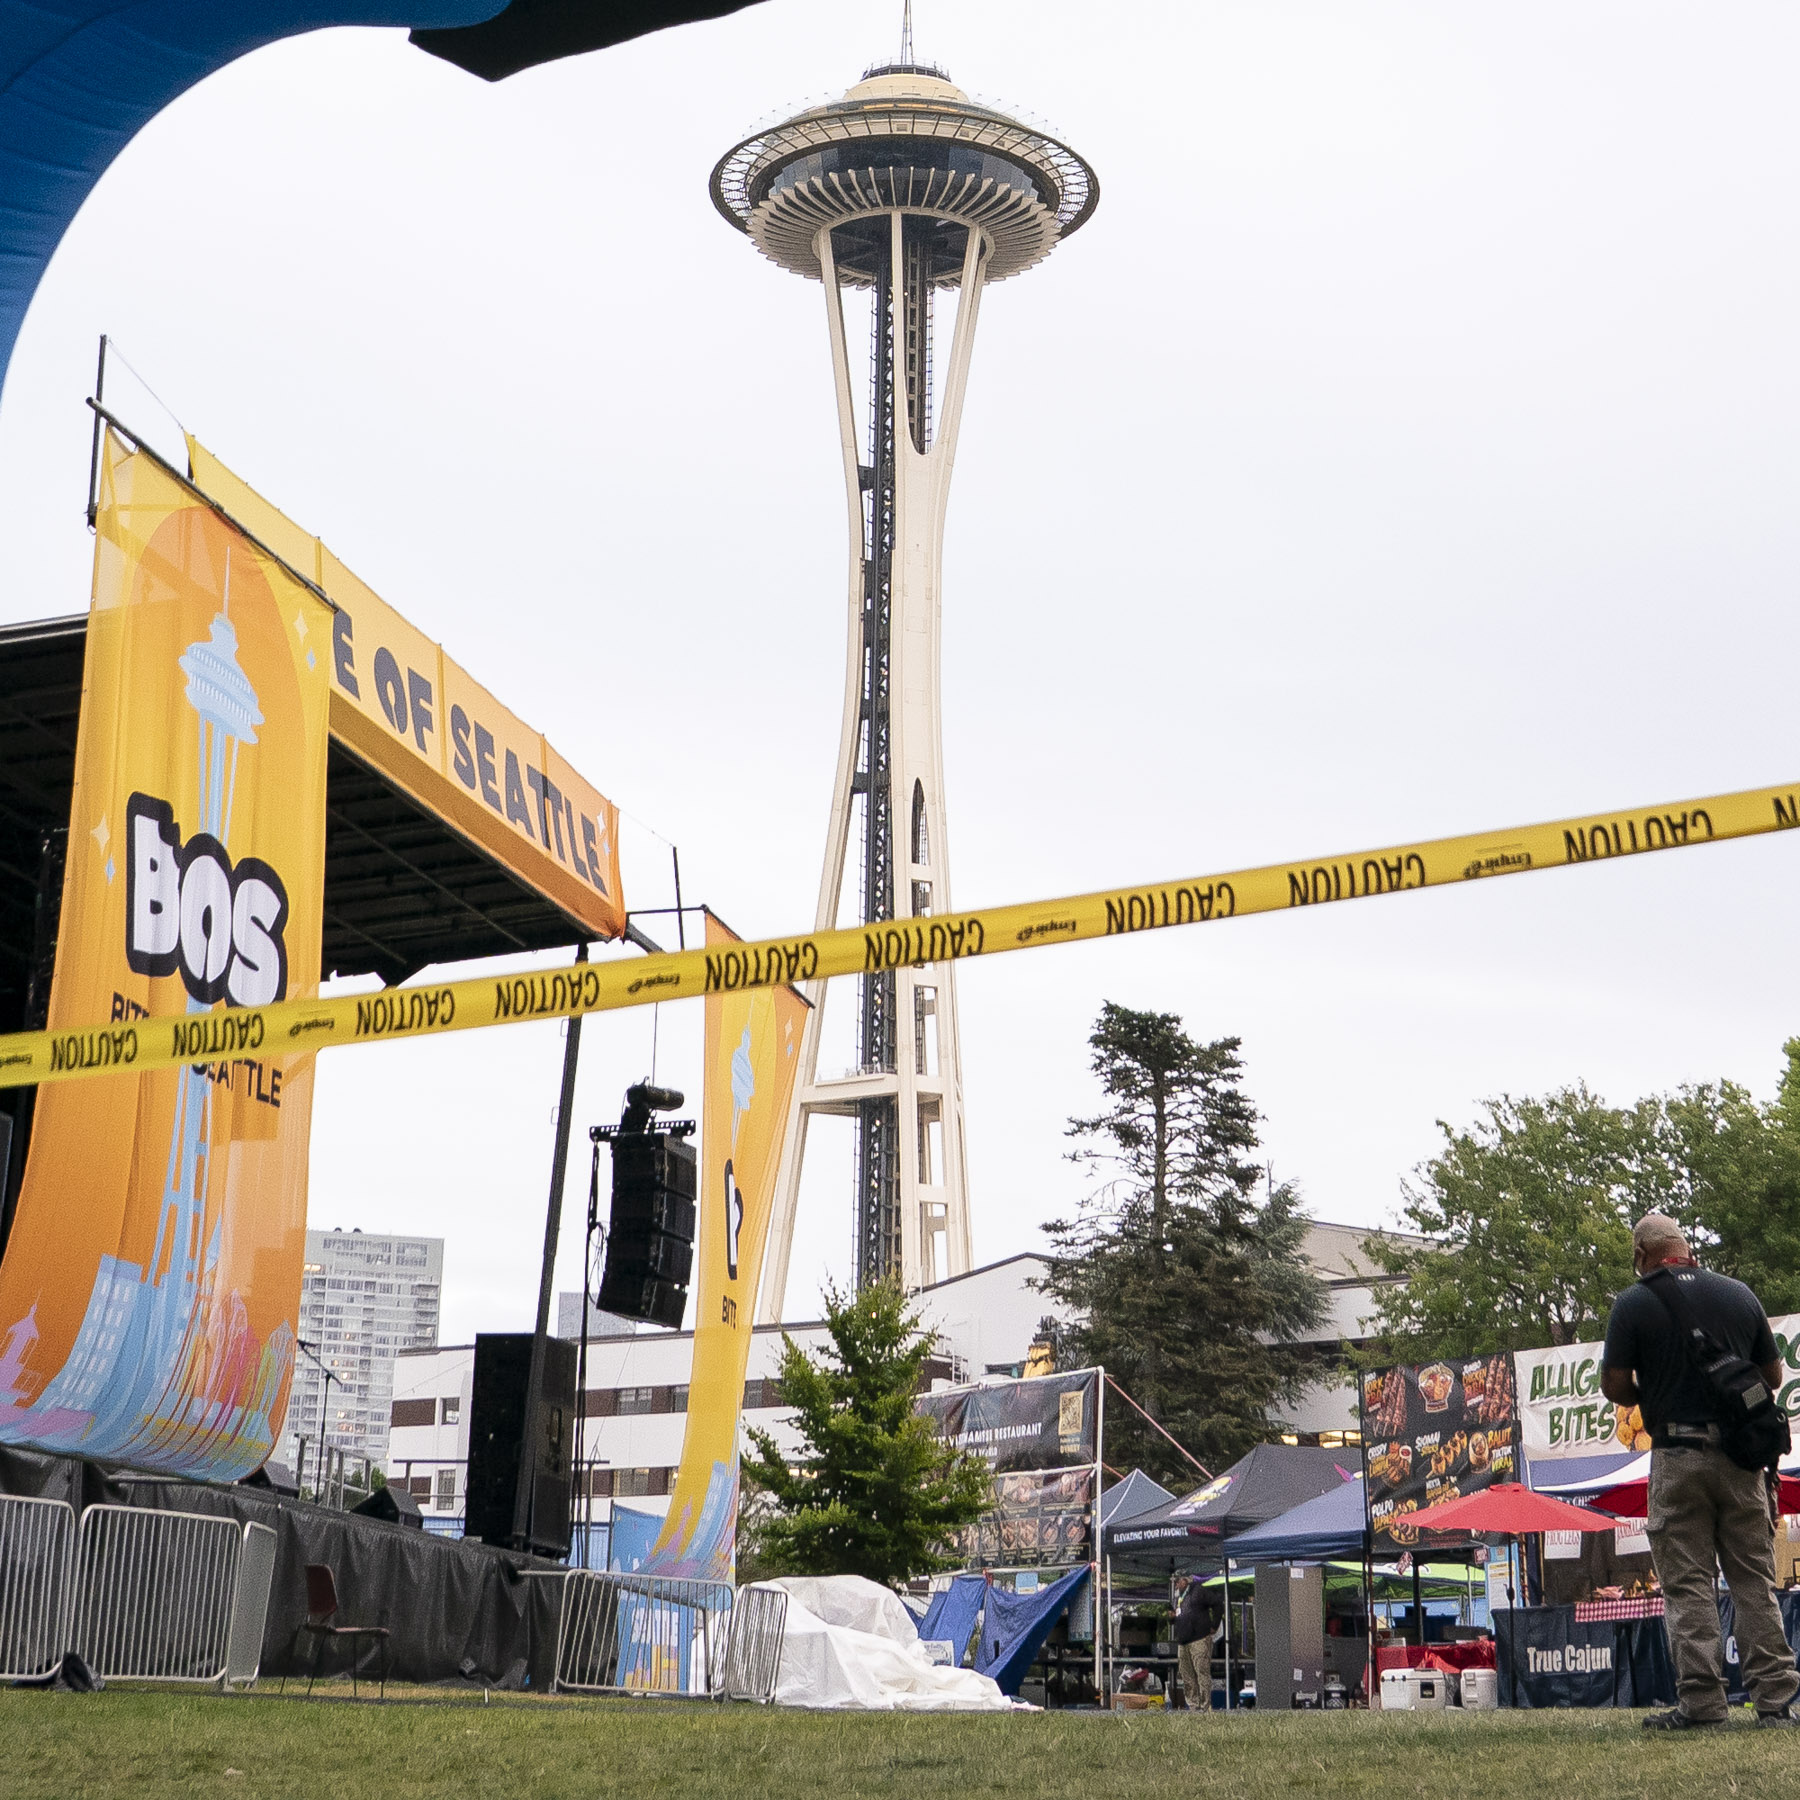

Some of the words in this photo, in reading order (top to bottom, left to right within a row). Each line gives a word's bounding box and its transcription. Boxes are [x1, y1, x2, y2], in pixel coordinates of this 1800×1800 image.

[374, 647, 433, 754] OF
[451, 704, 609, 898] SEATTLE
[128, 800, 286, 1008] BOS
[50, 1029, 138, 1071] CAUTION
[172, 1014, 264, 1058] CAUTION
[355, 989, 454, 1036] CAUTION
[495, 969, 601, 1018] CAUTION
[705, 942, 818, 991] CAUTION
[864, 918, 984, 971] CAUTION
[1105, 882, 1235, 935] CAUTION
[1287, 853, 1425, 907] CAUTION
[1563, 809, 1713, 863] CAUTION
[995, 1422, 1042, 1440] RESTAURANT
[1488, 1427, 1512, 1448] BALUT
[1549, 1403, 1616, 1445] BITES
[1144, 1528, 1159, 1540] YOUR
[1527, 1647, 1562, 1673] True
[1565, 1644, 1612, 1673] Cajun
